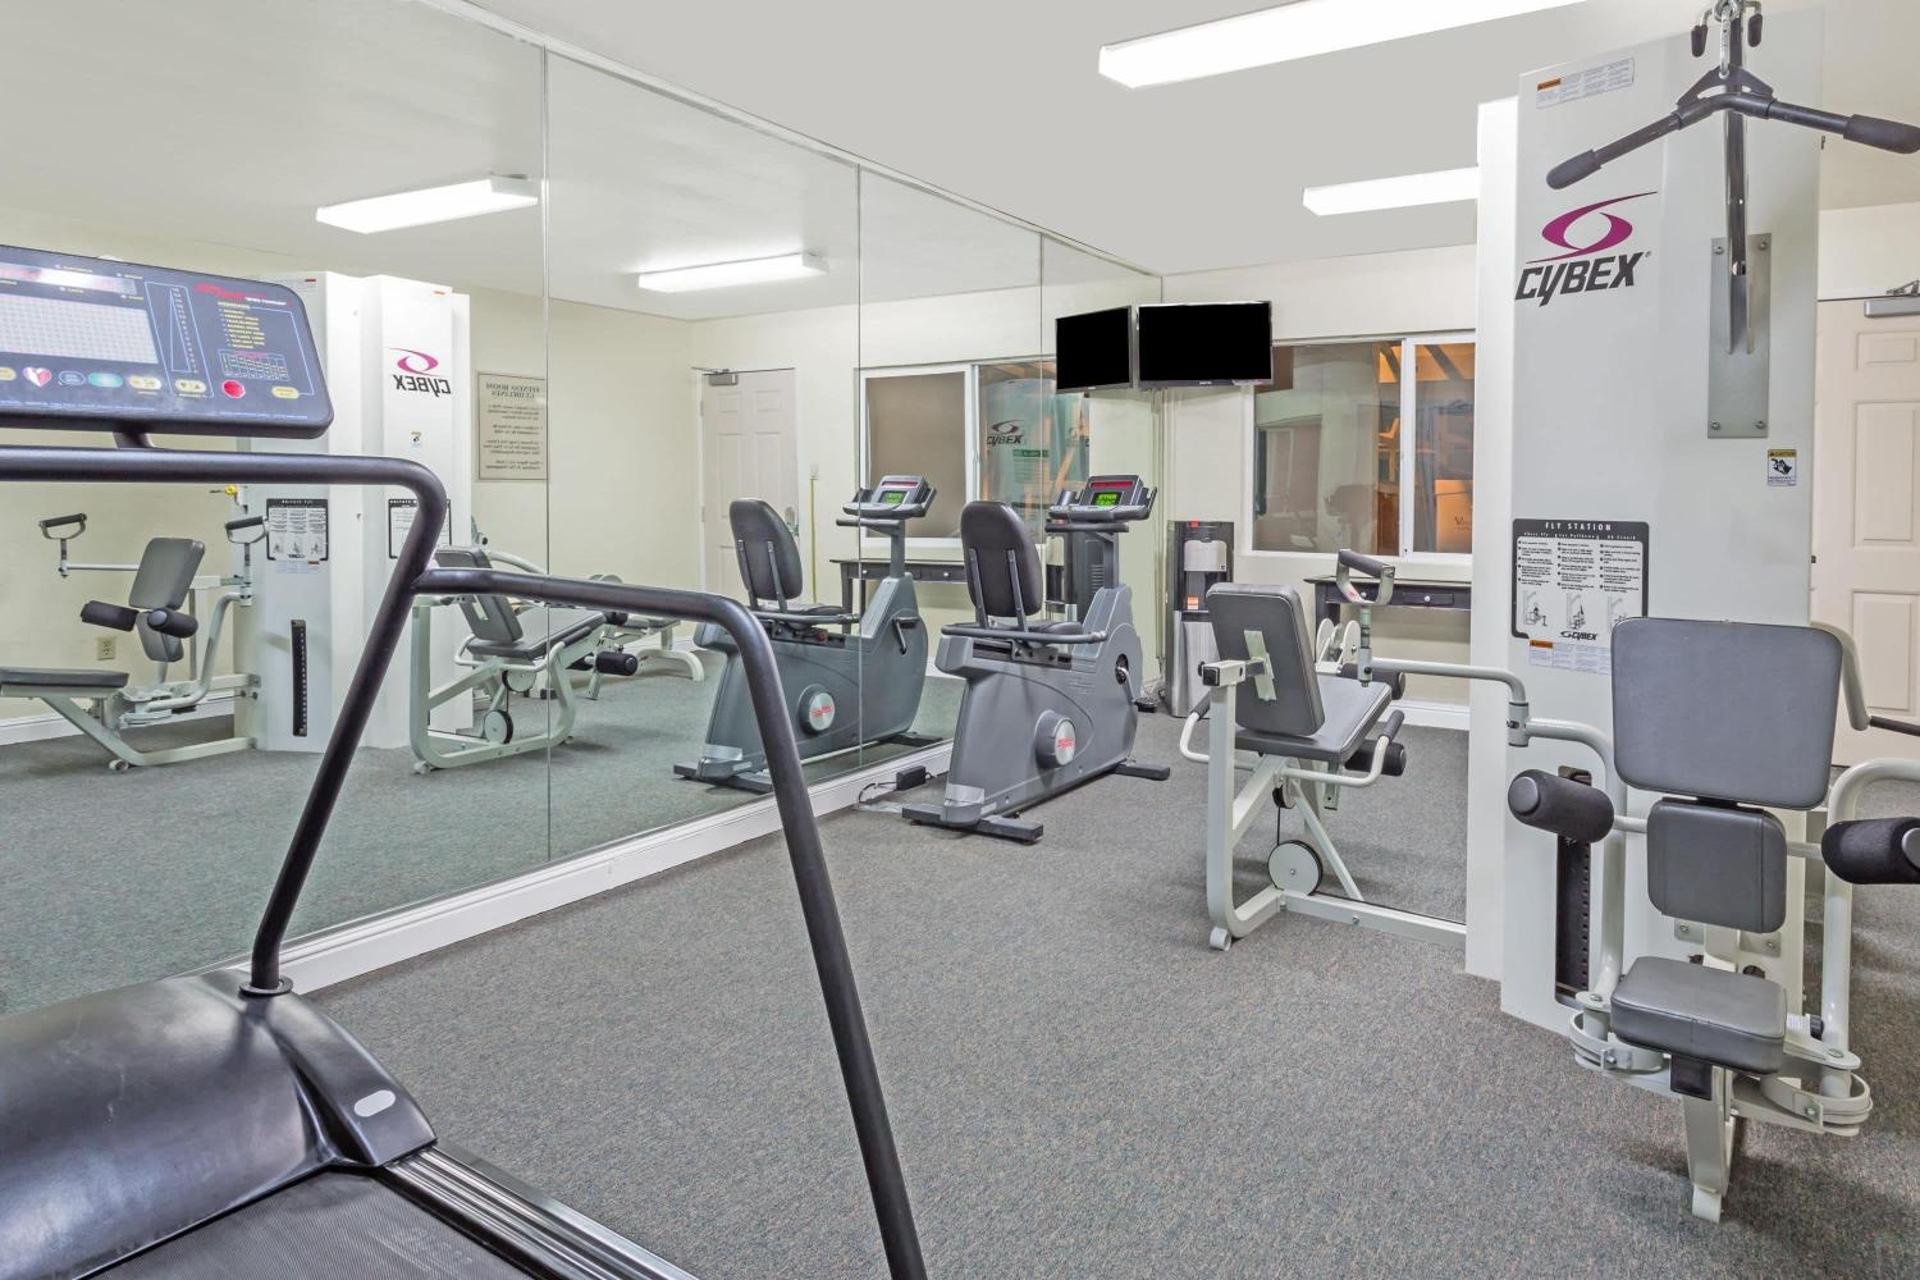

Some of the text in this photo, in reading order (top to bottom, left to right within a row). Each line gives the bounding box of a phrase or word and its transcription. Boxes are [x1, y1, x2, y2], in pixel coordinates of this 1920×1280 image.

[1515, 252, 1644, 307] CYBEX
[986, 434, 1023, 447] CYBEX
[1545, 522, 1611, 531] FLY STATION
[1571, 631, 1598, 641] CYBEX
